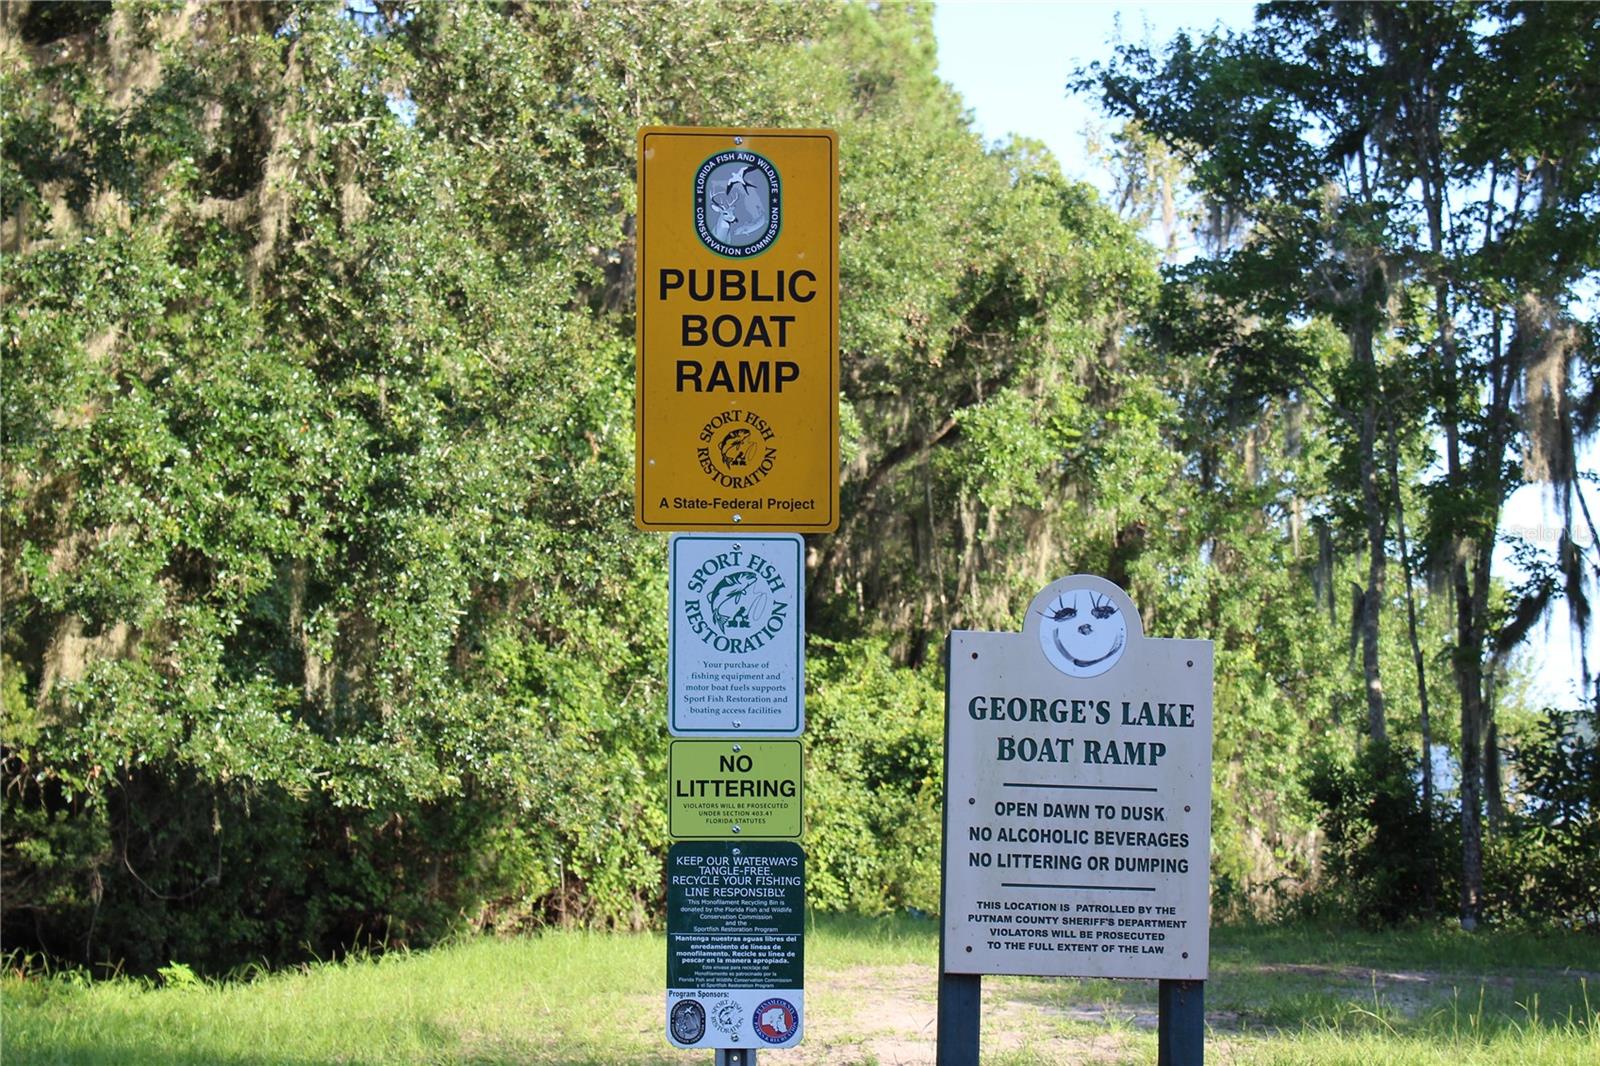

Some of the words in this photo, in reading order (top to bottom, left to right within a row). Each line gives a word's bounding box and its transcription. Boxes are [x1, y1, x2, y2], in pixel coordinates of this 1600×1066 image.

[697, 161, 716, 194] FLORIDA
[716, 153, 735, 163] FISH
[737, 154, 755, 163] AND
[757, 158, 778, 193] WILDLIFE
[697, 207, 741, 255] CONSERVATION
[745, 207, 778, 255] COMMISSION
[660, 269, 816, 303] PUBLIC
[682, 315, 795, 347] BOAT
[676, 360, 799, 393] RAMP
[700, 410, 742, 443] SPORT
[745, 412, 775, 441] FISH
[697, 447, 776, 489] RESTORATION
[659, 498, 669, 509] A
[674, 498, 763, 510] State-Federal
[768, 499, 814, 512] Project
[688, 551, 743, 593] SPORT
[747, 554, 785, 593] FISH
[685, 600, 788, 653] RESTORATION
[724, 661, 759, 671] purchase
[691, 672, 719, 680] fishing
[721, 673, 764, 681] equipment
[684, 695, 705, 704] Sport
[726, 695, 771, 703] Restoration
[690, 707, 720, 715] boating
[968, 696, 1110, 724] GEORGE'S
[1121, 701, 1195, 727] LAKE
[997, 737, 1073, 763] BOAT
[1084, 740, 1166, 766] RAMP
[720, 755, 752, 772] NO
[677, 780, 795, 797] LITTERING
[995, 801, 1038, 817] OPEN
[1044, 803, 1090, 819] DAWN
[1095, 805, 1115, 820] TO
[1122, 806, 1164, 821] DUSK
[969, 827, 992, 841] NO
[997, 828, 1088, 844] ALCOHOLIC
[1094, 831, 1189, 848] BEVERAGES
[676, 857, 703, 866] KEEP
[707, 857, 729, 866] OUR
[733, 857, 798, 866] WATERWAYS
[969, 853, 991, 867] NO
[997, 853, 1082, 870] LITTERING
[1088, 856, 1109, 870] OR
[1115, 857, 1189, 873] DUMPING
[699, 867, 773, 875] TANGLE-FREE.
[672, 876, 719, 885] RECYCLE
[723, 876, 752, 885] YOUR
[756, 877, 800, 885] FISHING
[685, 888, 709, 896] LINE
[977, 901, 1000, 910] THIS
[1004, 902, 1056, 911] LOCATION
[1060, 903, 1070, 911] IS
[1076, 904, 1134, 914] PATROLLED
[1138, 906, 1153, 914] BY
[1155, 906, 1176, 915] THE
[968, 915, 1012, 923] PUTNAM
[1015, 916, 1059, 925] COUNTY
[1062, 917, 1115, 926] SHERIFF'S
[1118, 918, 1187, 928] DEPARTMENT
[990, 928, 1048, 938] VIOLATORS
[1052, 930, 1077, 938] WILL
[1080, 931, 1093, 939] BE
[1096, 931, 1165, 941] PROSECUTED
[987, 941, 1001, 950] TO
[1005, 941, 1025, 950] THE
[1028, 942, 1054, 951] FULL
[1057, 943, 1098, 952] EXTENT
[1118, 945, 1139, 953] THE
[1142, 946, 1164, 954] LAW
